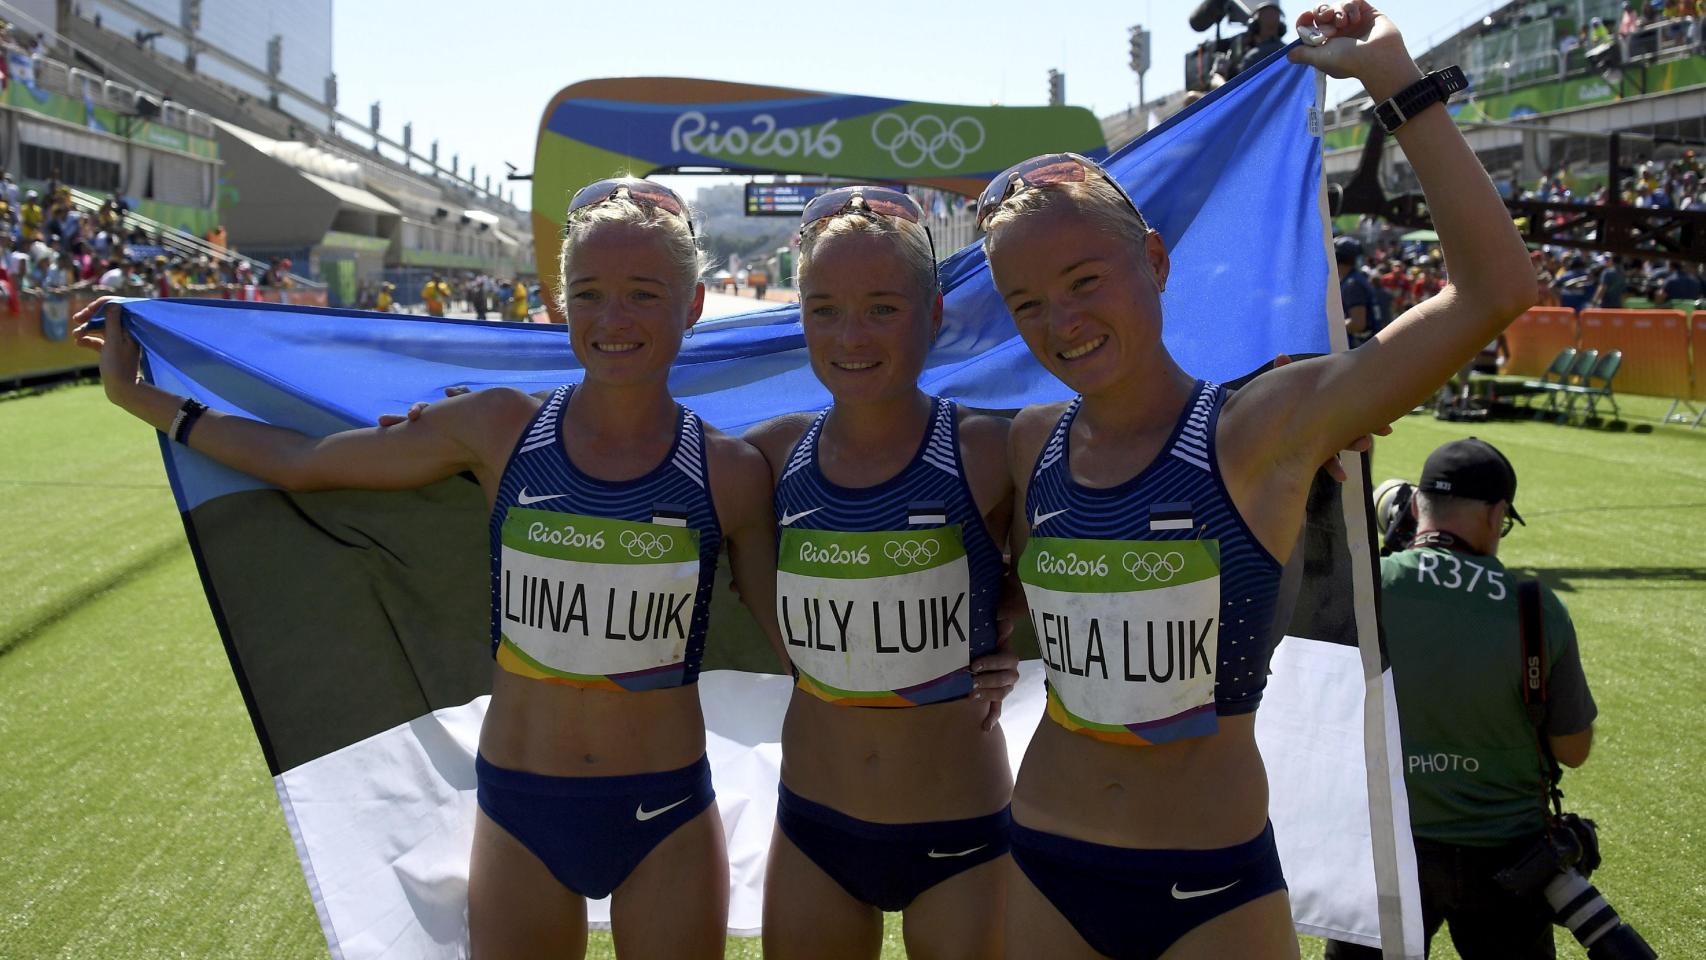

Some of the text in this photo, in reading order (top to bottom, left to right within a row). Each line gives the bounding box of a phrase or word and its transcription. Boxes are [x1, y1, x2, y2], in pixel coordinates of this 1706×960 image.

[1418, 552, 1506, 600] R375
[505, 569, 692, 642] LIINA LUIK
[782, 592, 967, 653] LILY LUIK
[1123, 617, 1214, 683] LUIK
[1528, 656, 1540, 689] EOS
[1408, 753, 1479, 774] PHOTO
